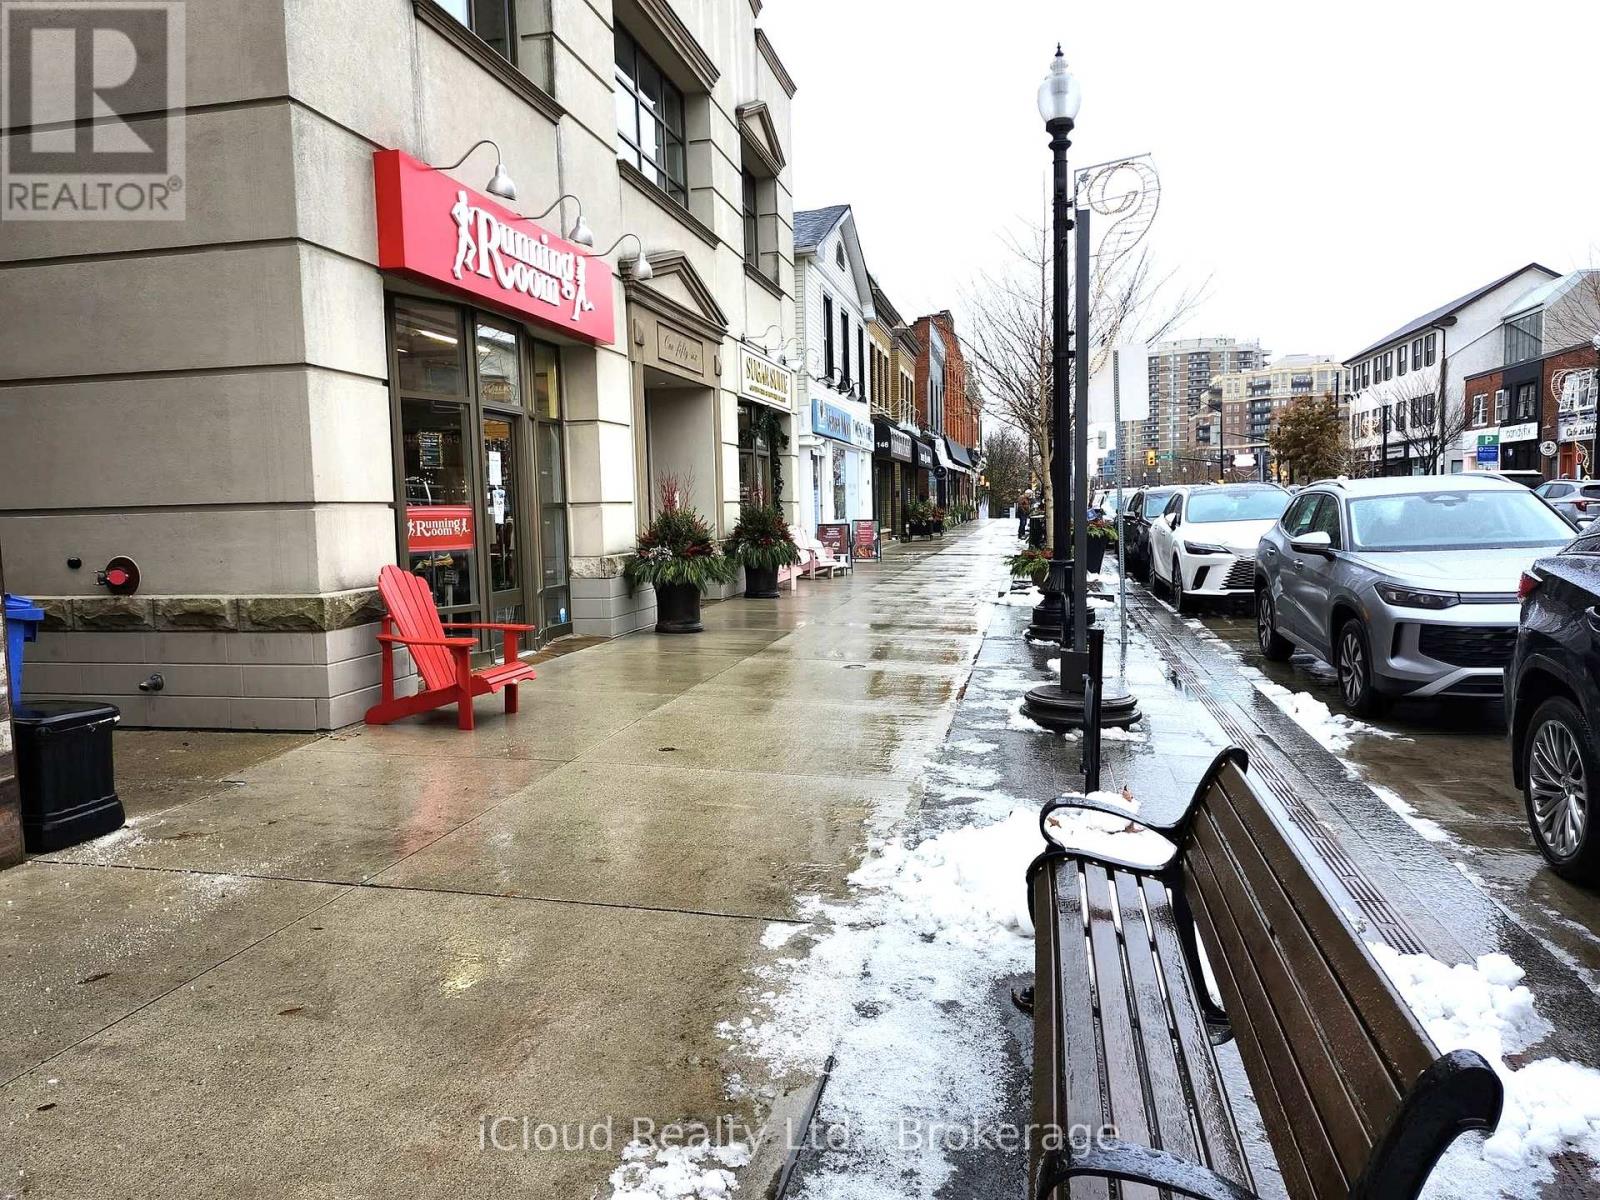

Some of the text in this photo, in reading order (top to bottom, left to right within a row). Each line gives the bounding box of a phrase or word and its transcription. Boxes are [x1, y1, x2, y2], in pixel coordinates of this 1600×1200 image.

[468, 206, 575, 300] Running
[876, 442, 889, 450] 146
[1484, 435, 1493, 445] P
[416, 518, 460, 535] Running
